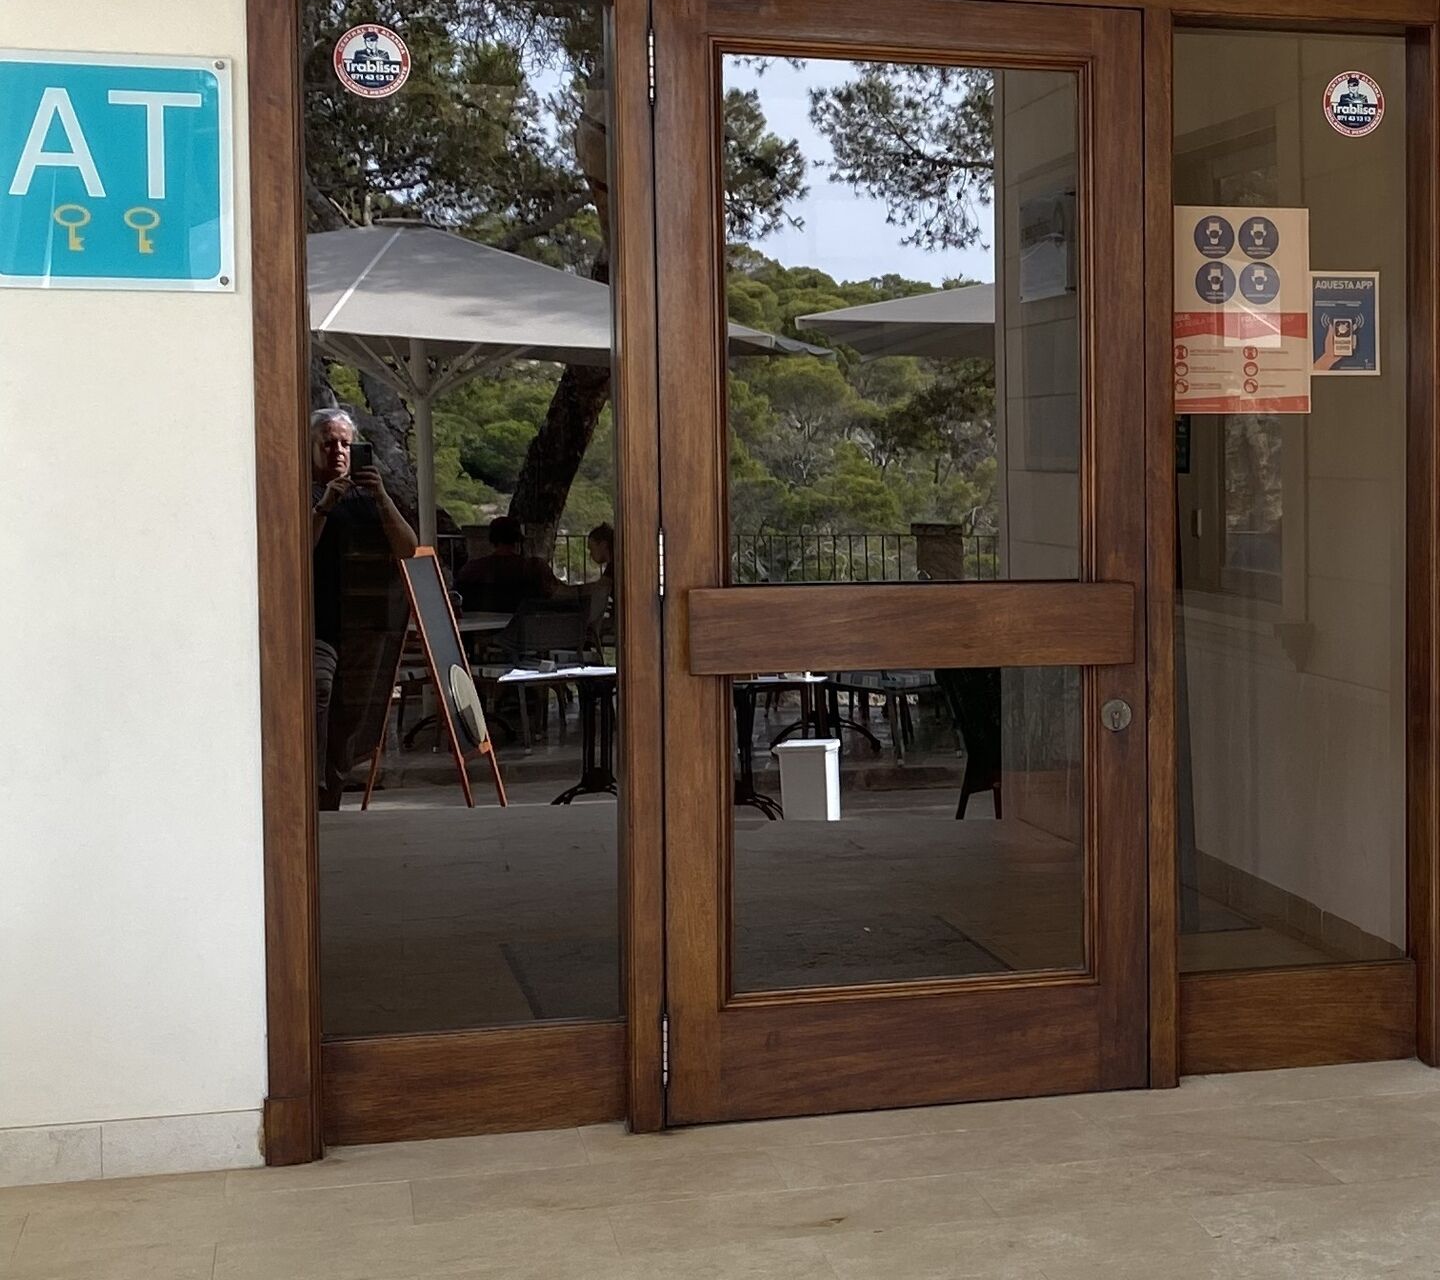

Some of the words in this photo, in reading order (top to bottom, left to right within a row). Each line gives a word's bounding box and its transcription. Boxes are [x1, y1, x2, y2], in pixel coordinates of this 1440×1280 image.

[338, 27, 366, 53] CENTRAL
[343, 60, 400, 73] Trablisa
[1331, 103, 1376, 115] Trablisa
[8, 87, 202, 199] AT
[1315, 280, 1355, 290] AQUESTA
[1355, 281, 1373, 290] APP
